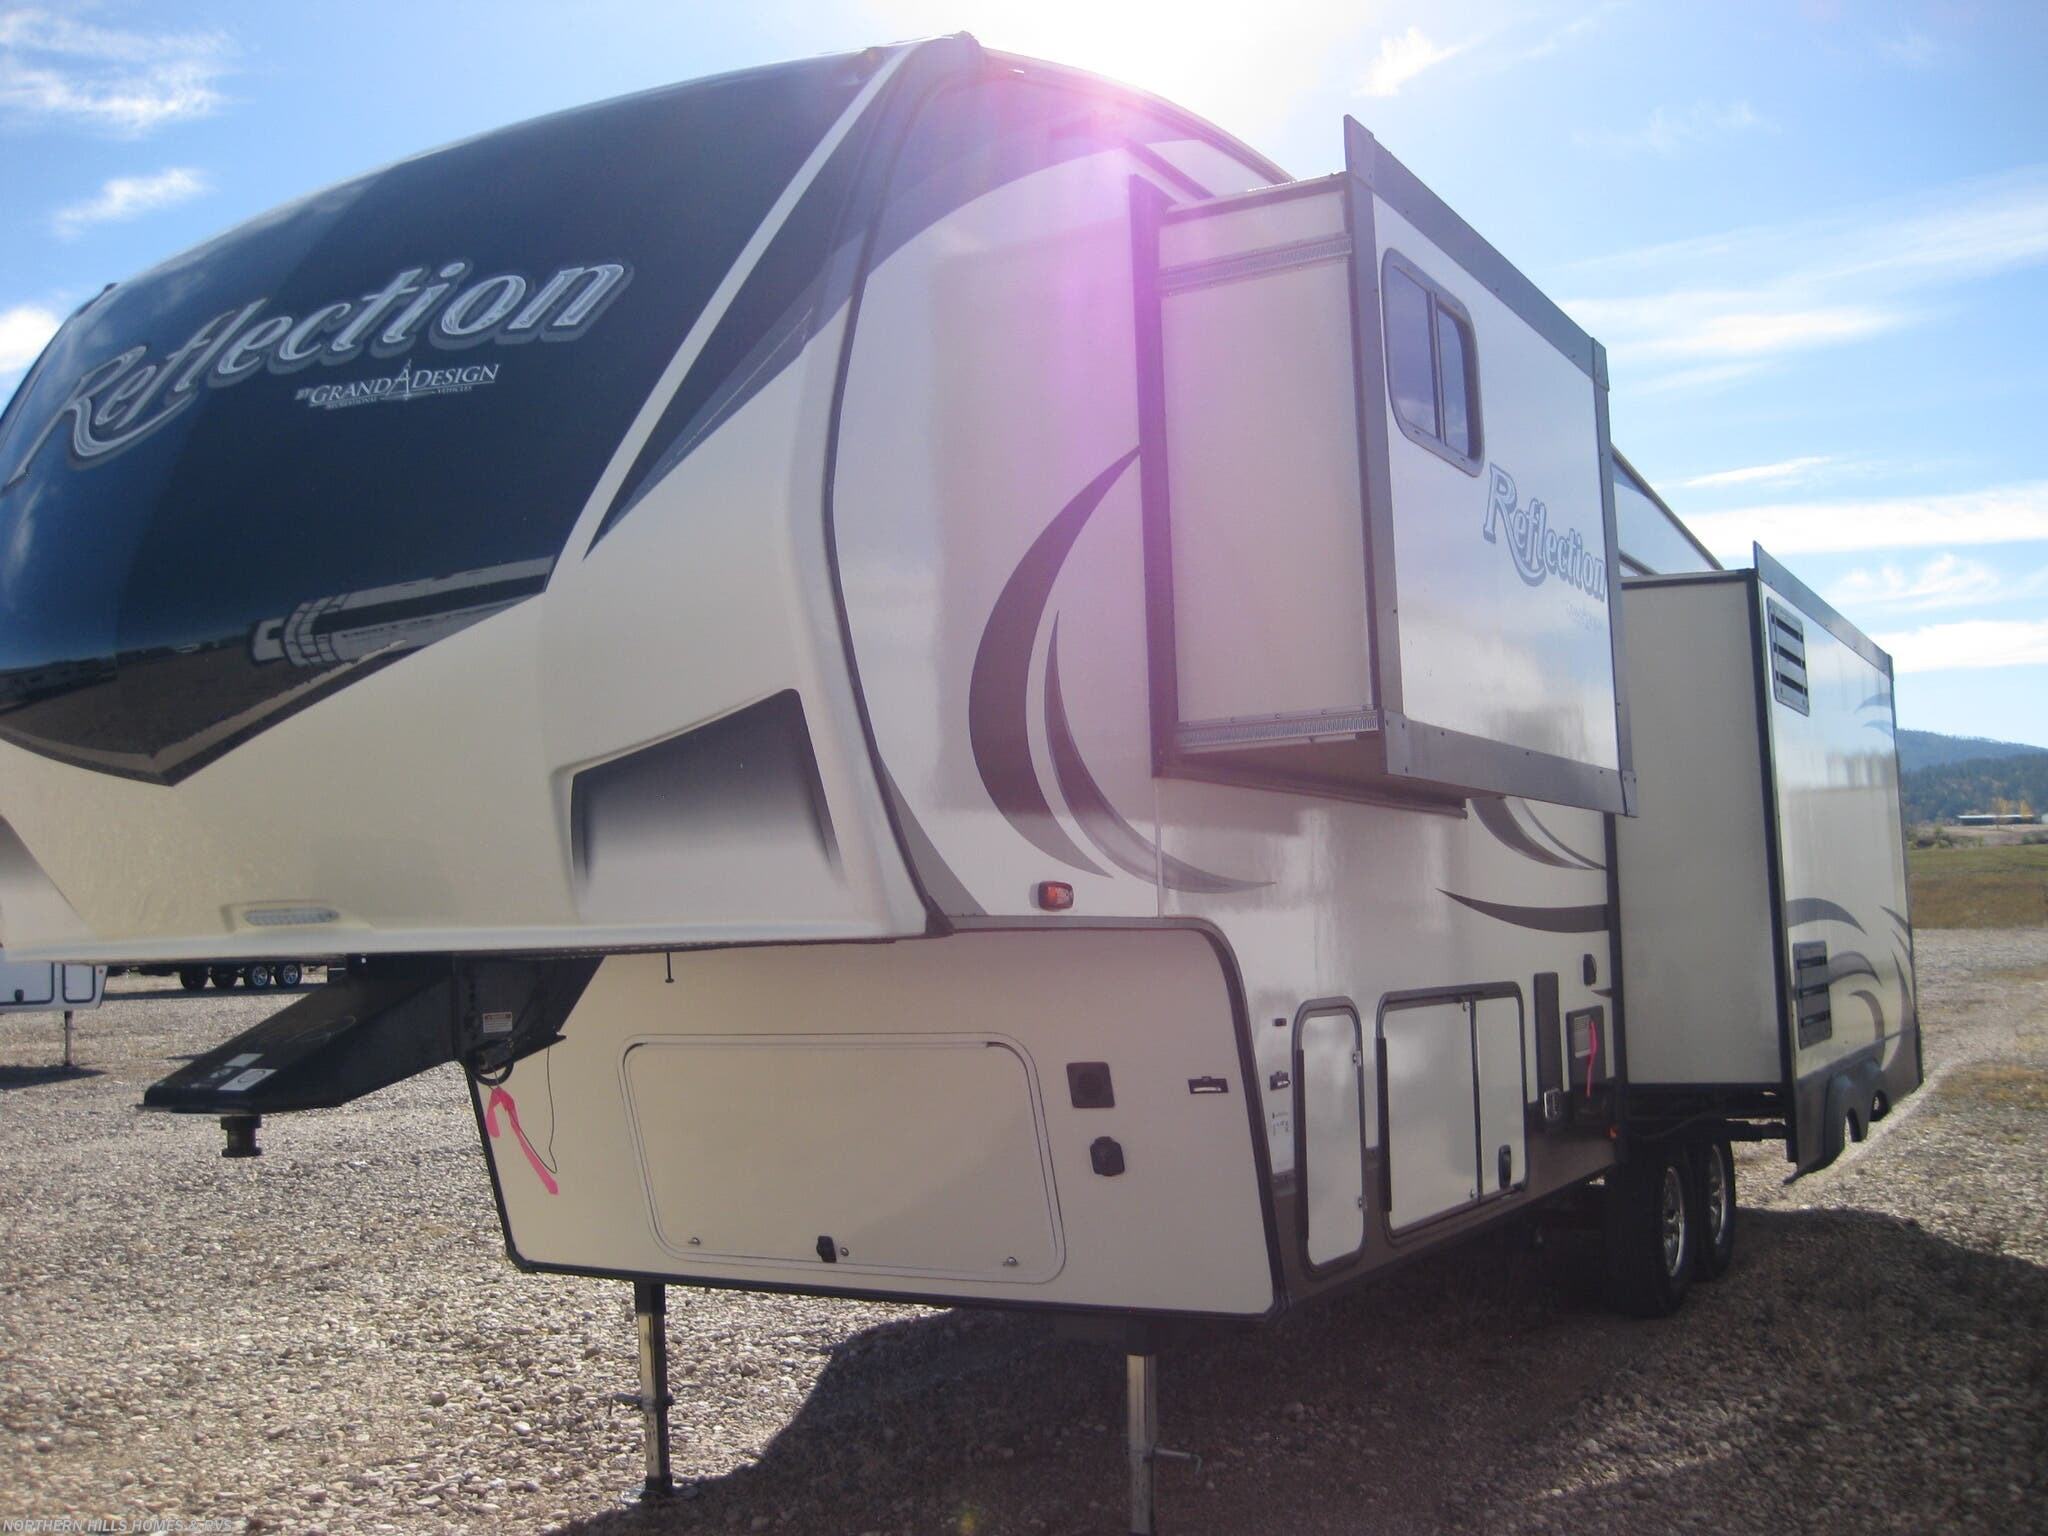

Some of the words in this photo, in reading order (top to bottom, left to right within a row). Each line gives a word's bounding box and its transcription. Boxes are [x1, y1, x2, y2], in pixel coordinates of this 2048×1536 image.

[6, 260, 630, 487] Reflection
[309, 376, 391, 405] GRAND
[411, 363, 500, 389] DESIGN
[1483, 462, 1607, 602] Reflection
